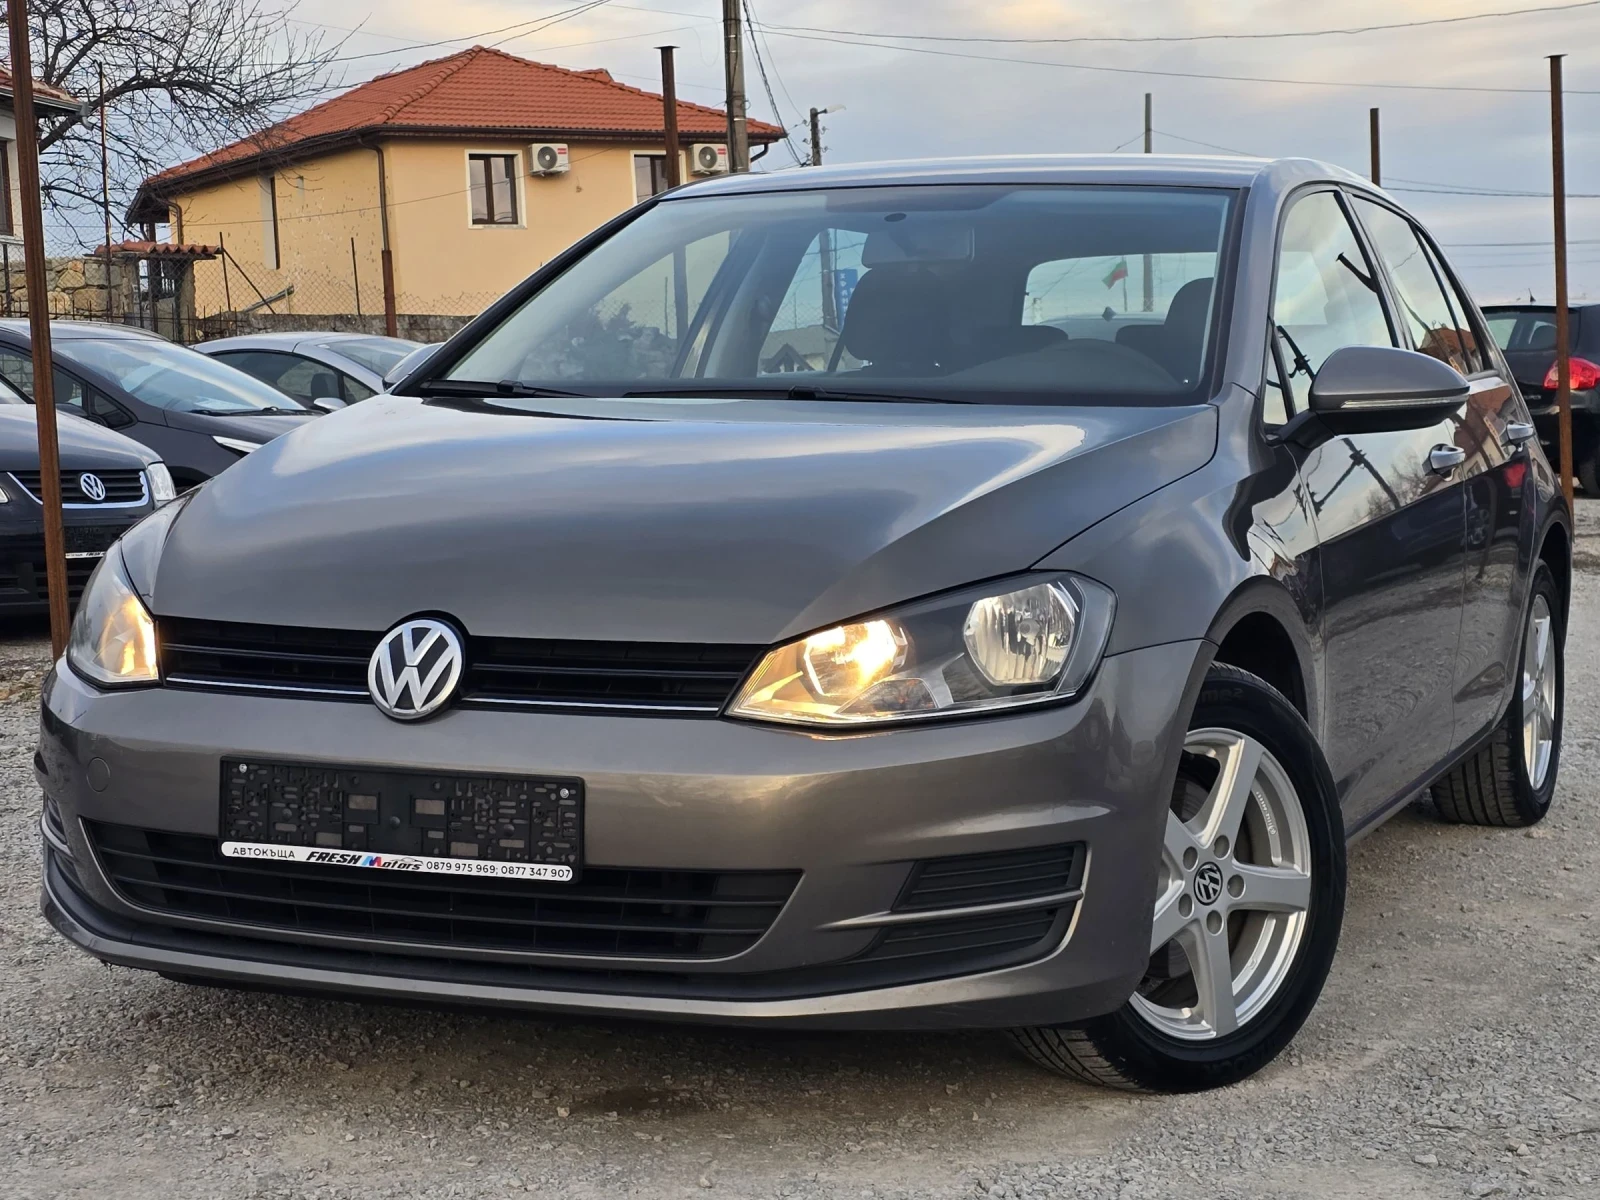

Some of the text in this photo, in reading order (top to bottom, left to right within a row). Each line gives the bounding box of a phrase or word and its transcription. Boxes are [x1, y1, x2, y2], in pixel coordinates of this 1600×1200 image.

[81, 474, 105, 500] VW
[370, 621, 461, 717] VW
[232, 846, 571, 878] АВТОКЪЩА FRESH Motors 0879 975 969; 0877 347 907
